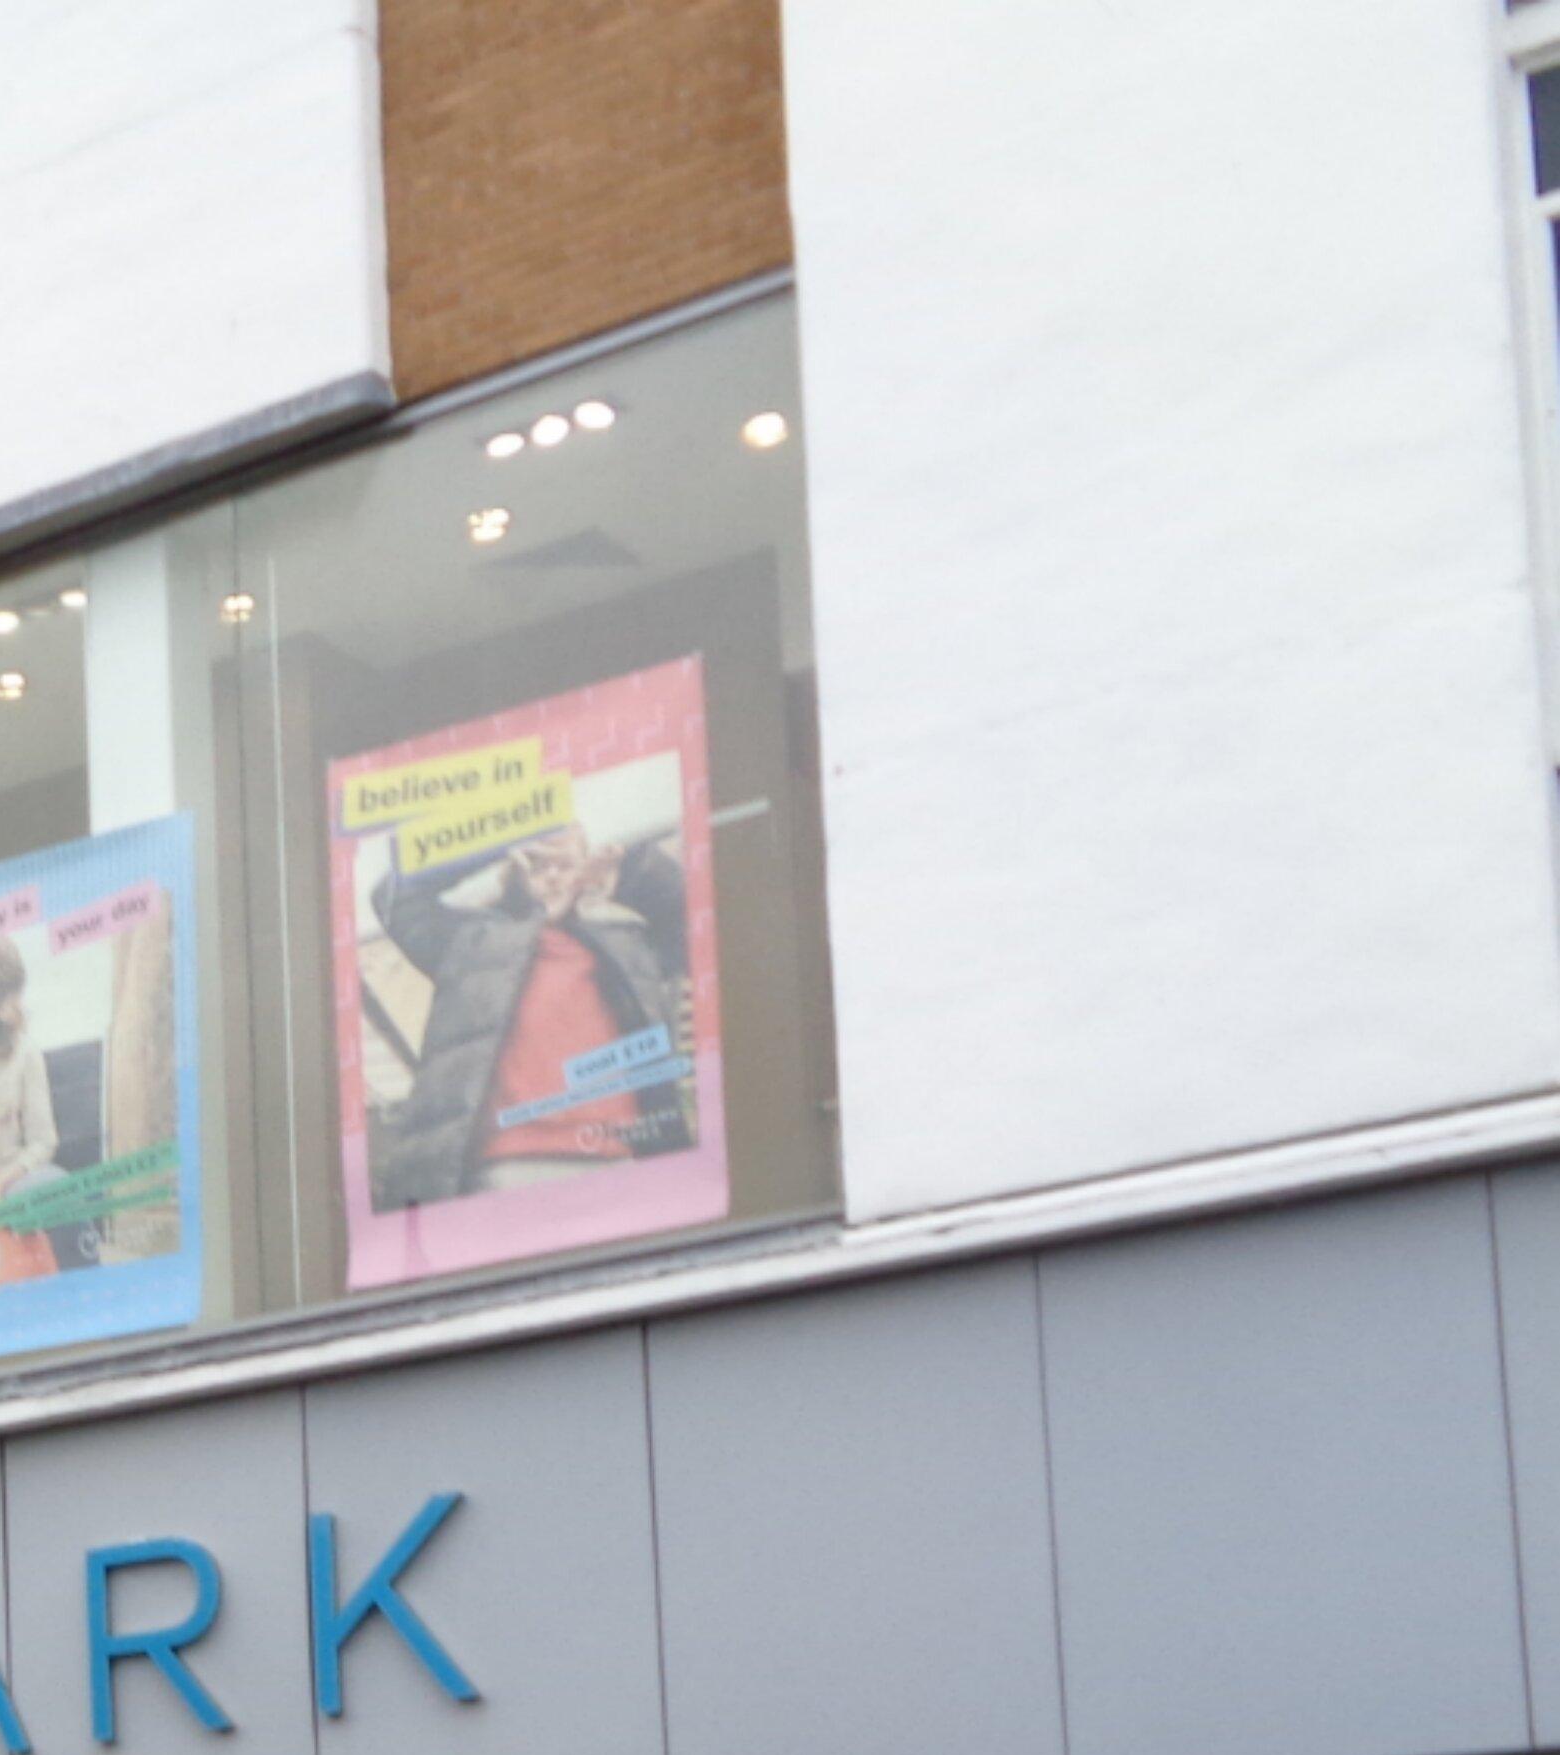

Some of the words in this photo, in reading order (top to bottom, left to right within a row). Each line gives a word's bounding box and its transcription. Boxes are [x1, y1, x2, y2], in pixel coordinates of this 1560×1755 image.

[359, 769, 481, 813] believe
[493, 757, 523, 785] in
[414, 786, 555, 863] yourself
[14, 898, 32, 917] is
[58, 913, 104, 948] your
[111, 893, 150, 922] day
